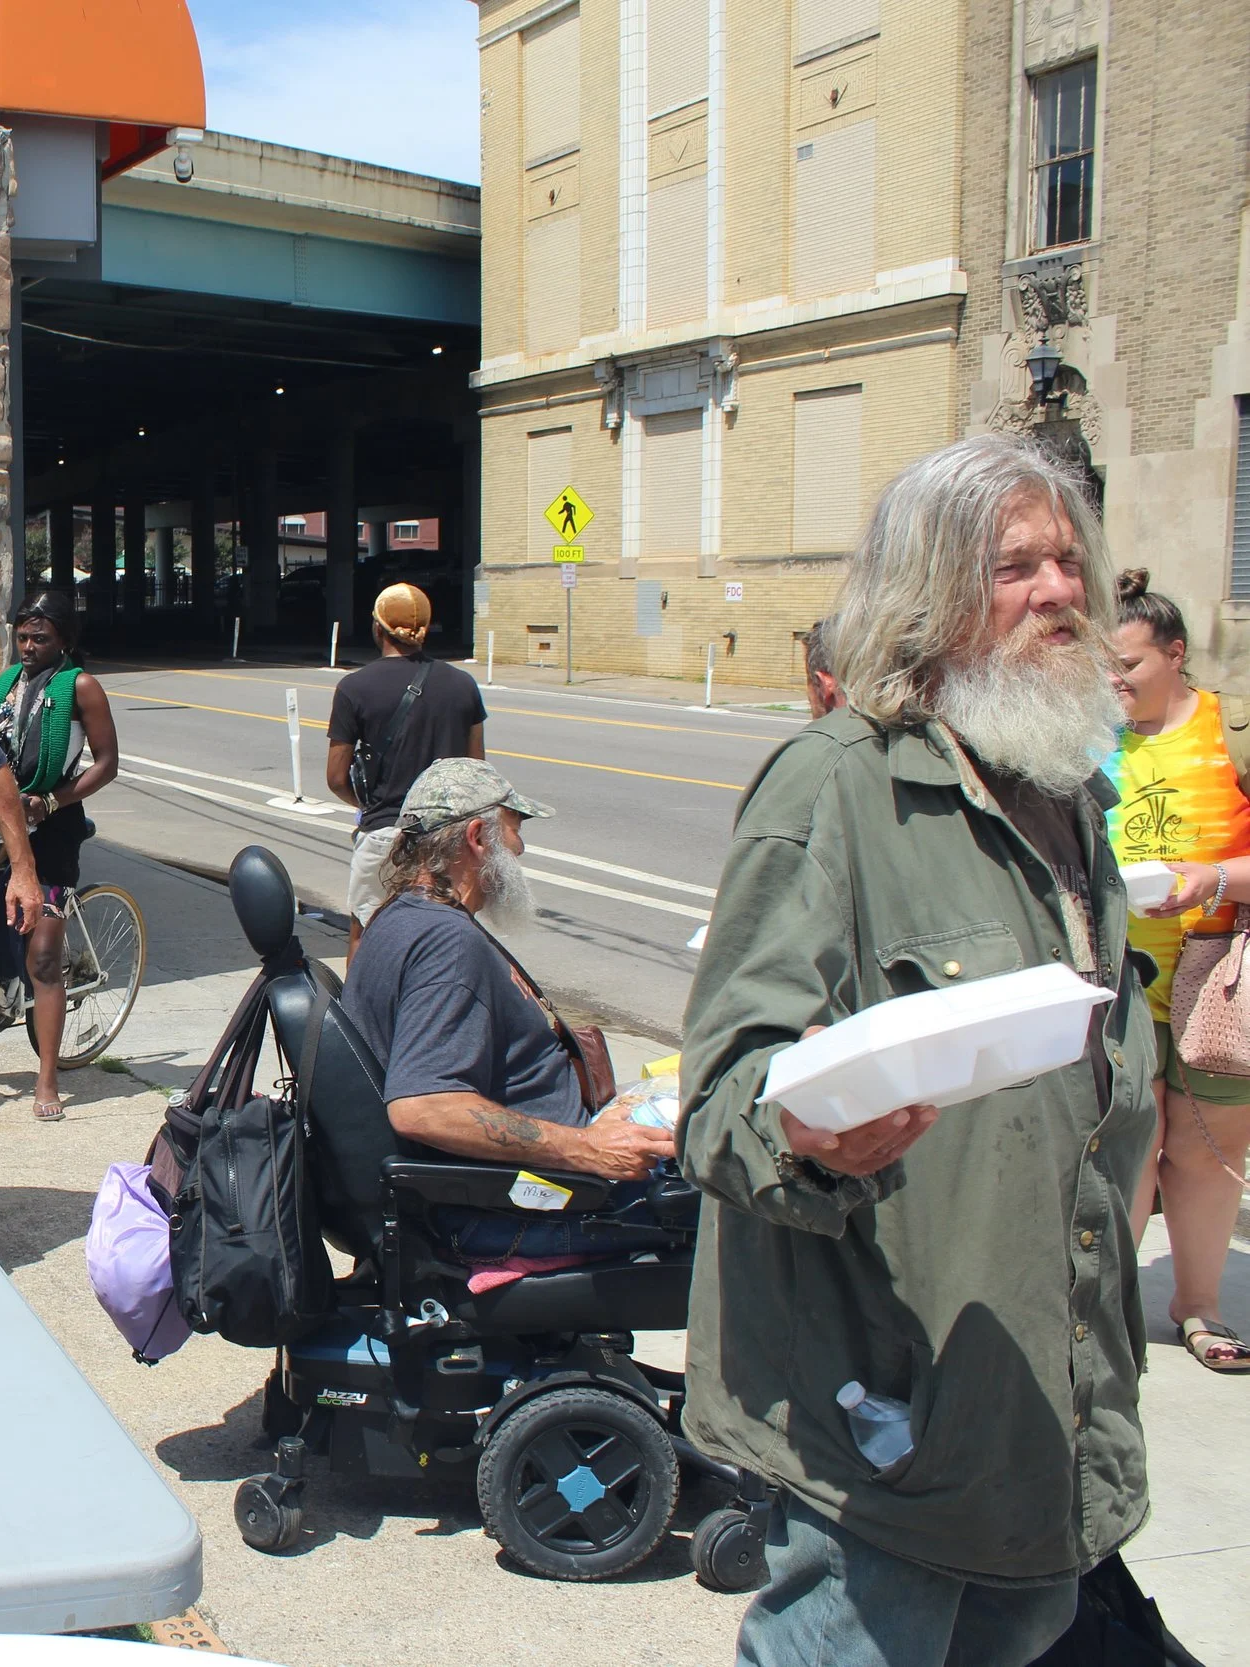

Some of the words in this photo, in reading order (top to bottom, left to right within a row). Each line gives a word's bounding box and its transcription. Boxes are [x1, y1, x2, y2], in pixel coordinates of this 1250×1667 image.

[557, 550, 570, 558] 100
[572, 550, 582, 558] FT
[726, 586, 742, 597] FDC
[1124, 844, 1179, 855] Seattle
[317, 1388, 368, 1405] Jazzy
